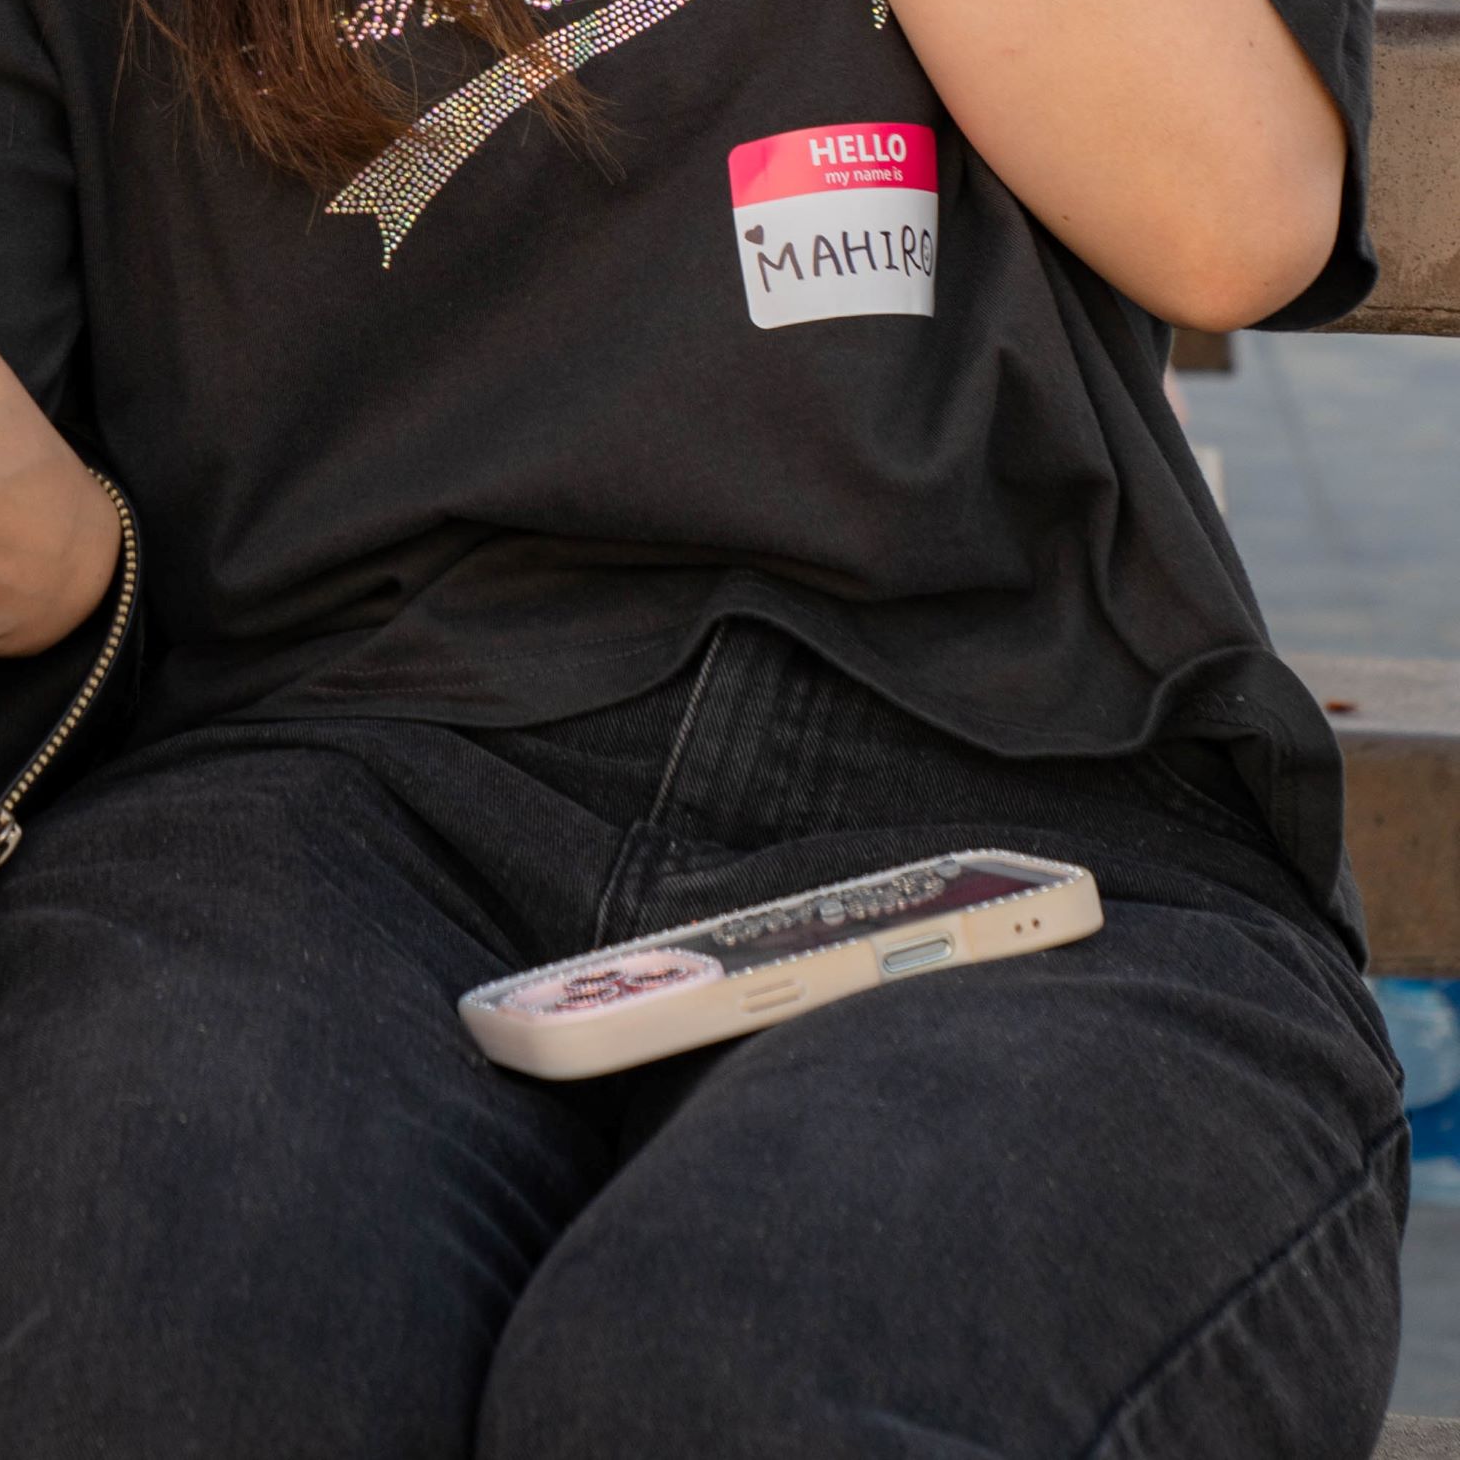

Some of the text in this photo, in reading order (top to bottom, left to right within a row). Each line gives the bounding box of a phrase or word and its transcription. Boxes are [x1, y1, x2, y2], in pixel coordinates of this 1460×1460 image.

[809, 133, 907, 167] HELLO
[825, 166, 904, 187] my name is
[757, 224, 934, 293] MAHIRO
